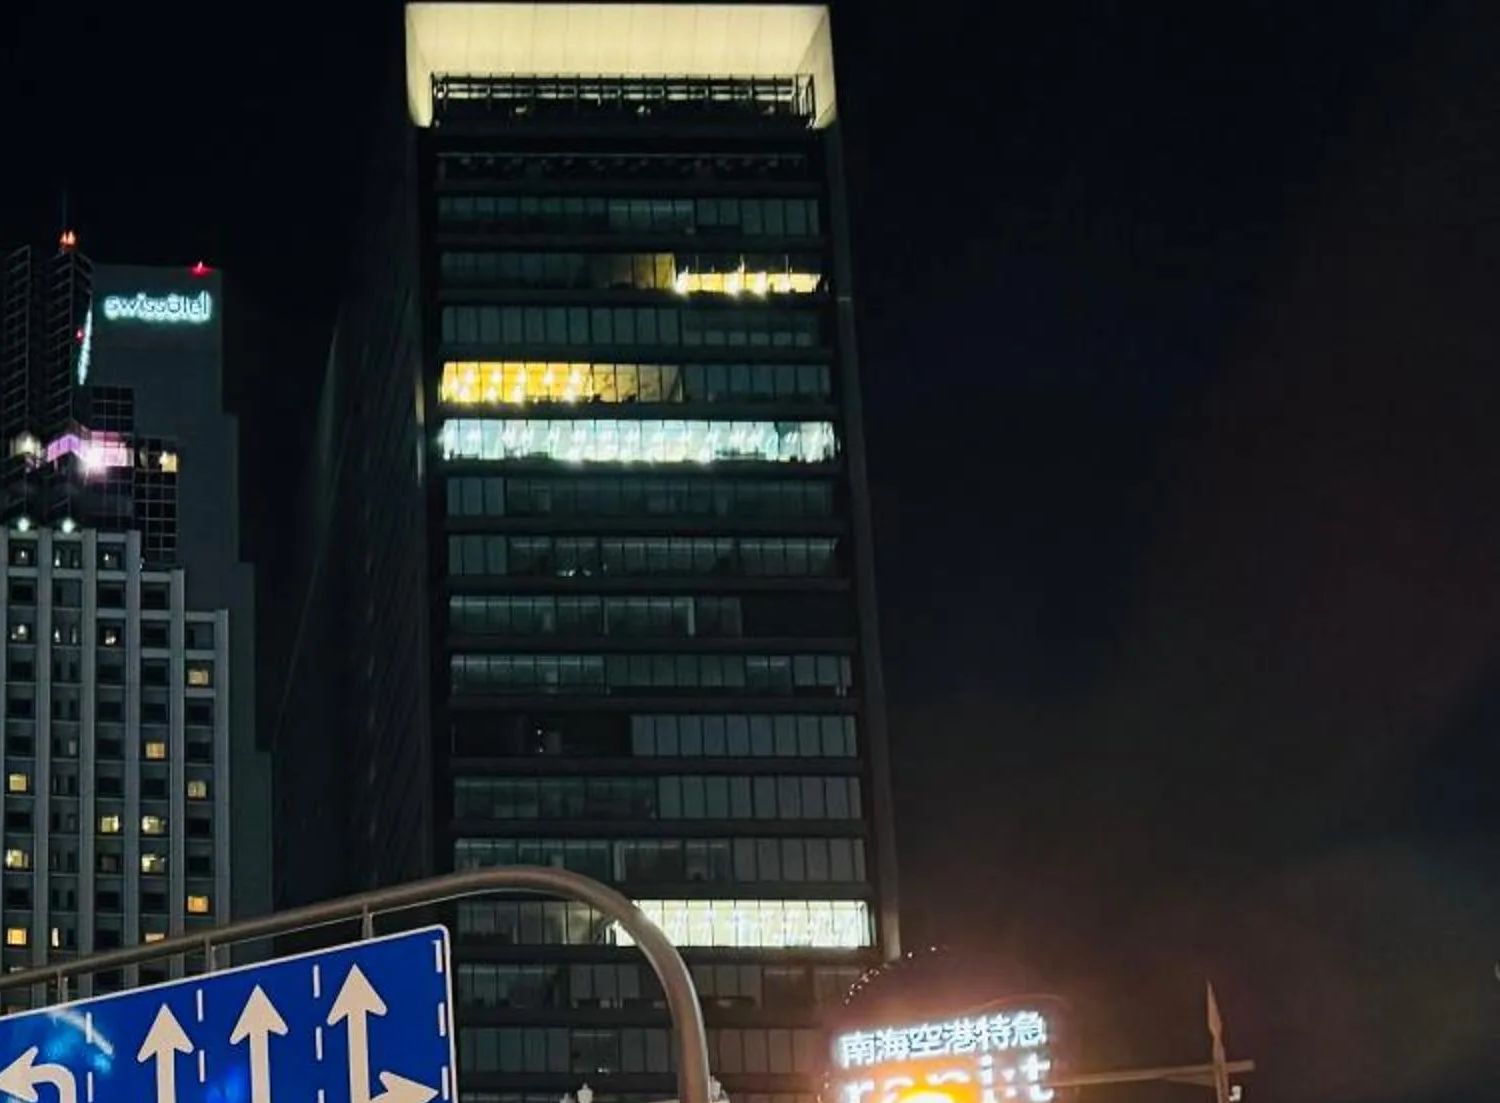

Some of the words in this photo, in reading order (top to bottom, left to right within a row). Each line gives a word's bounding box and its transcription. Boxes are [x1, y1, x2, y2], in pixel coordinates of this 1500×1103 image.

[838, 1010, 1047, 1068] 南海空港特急
